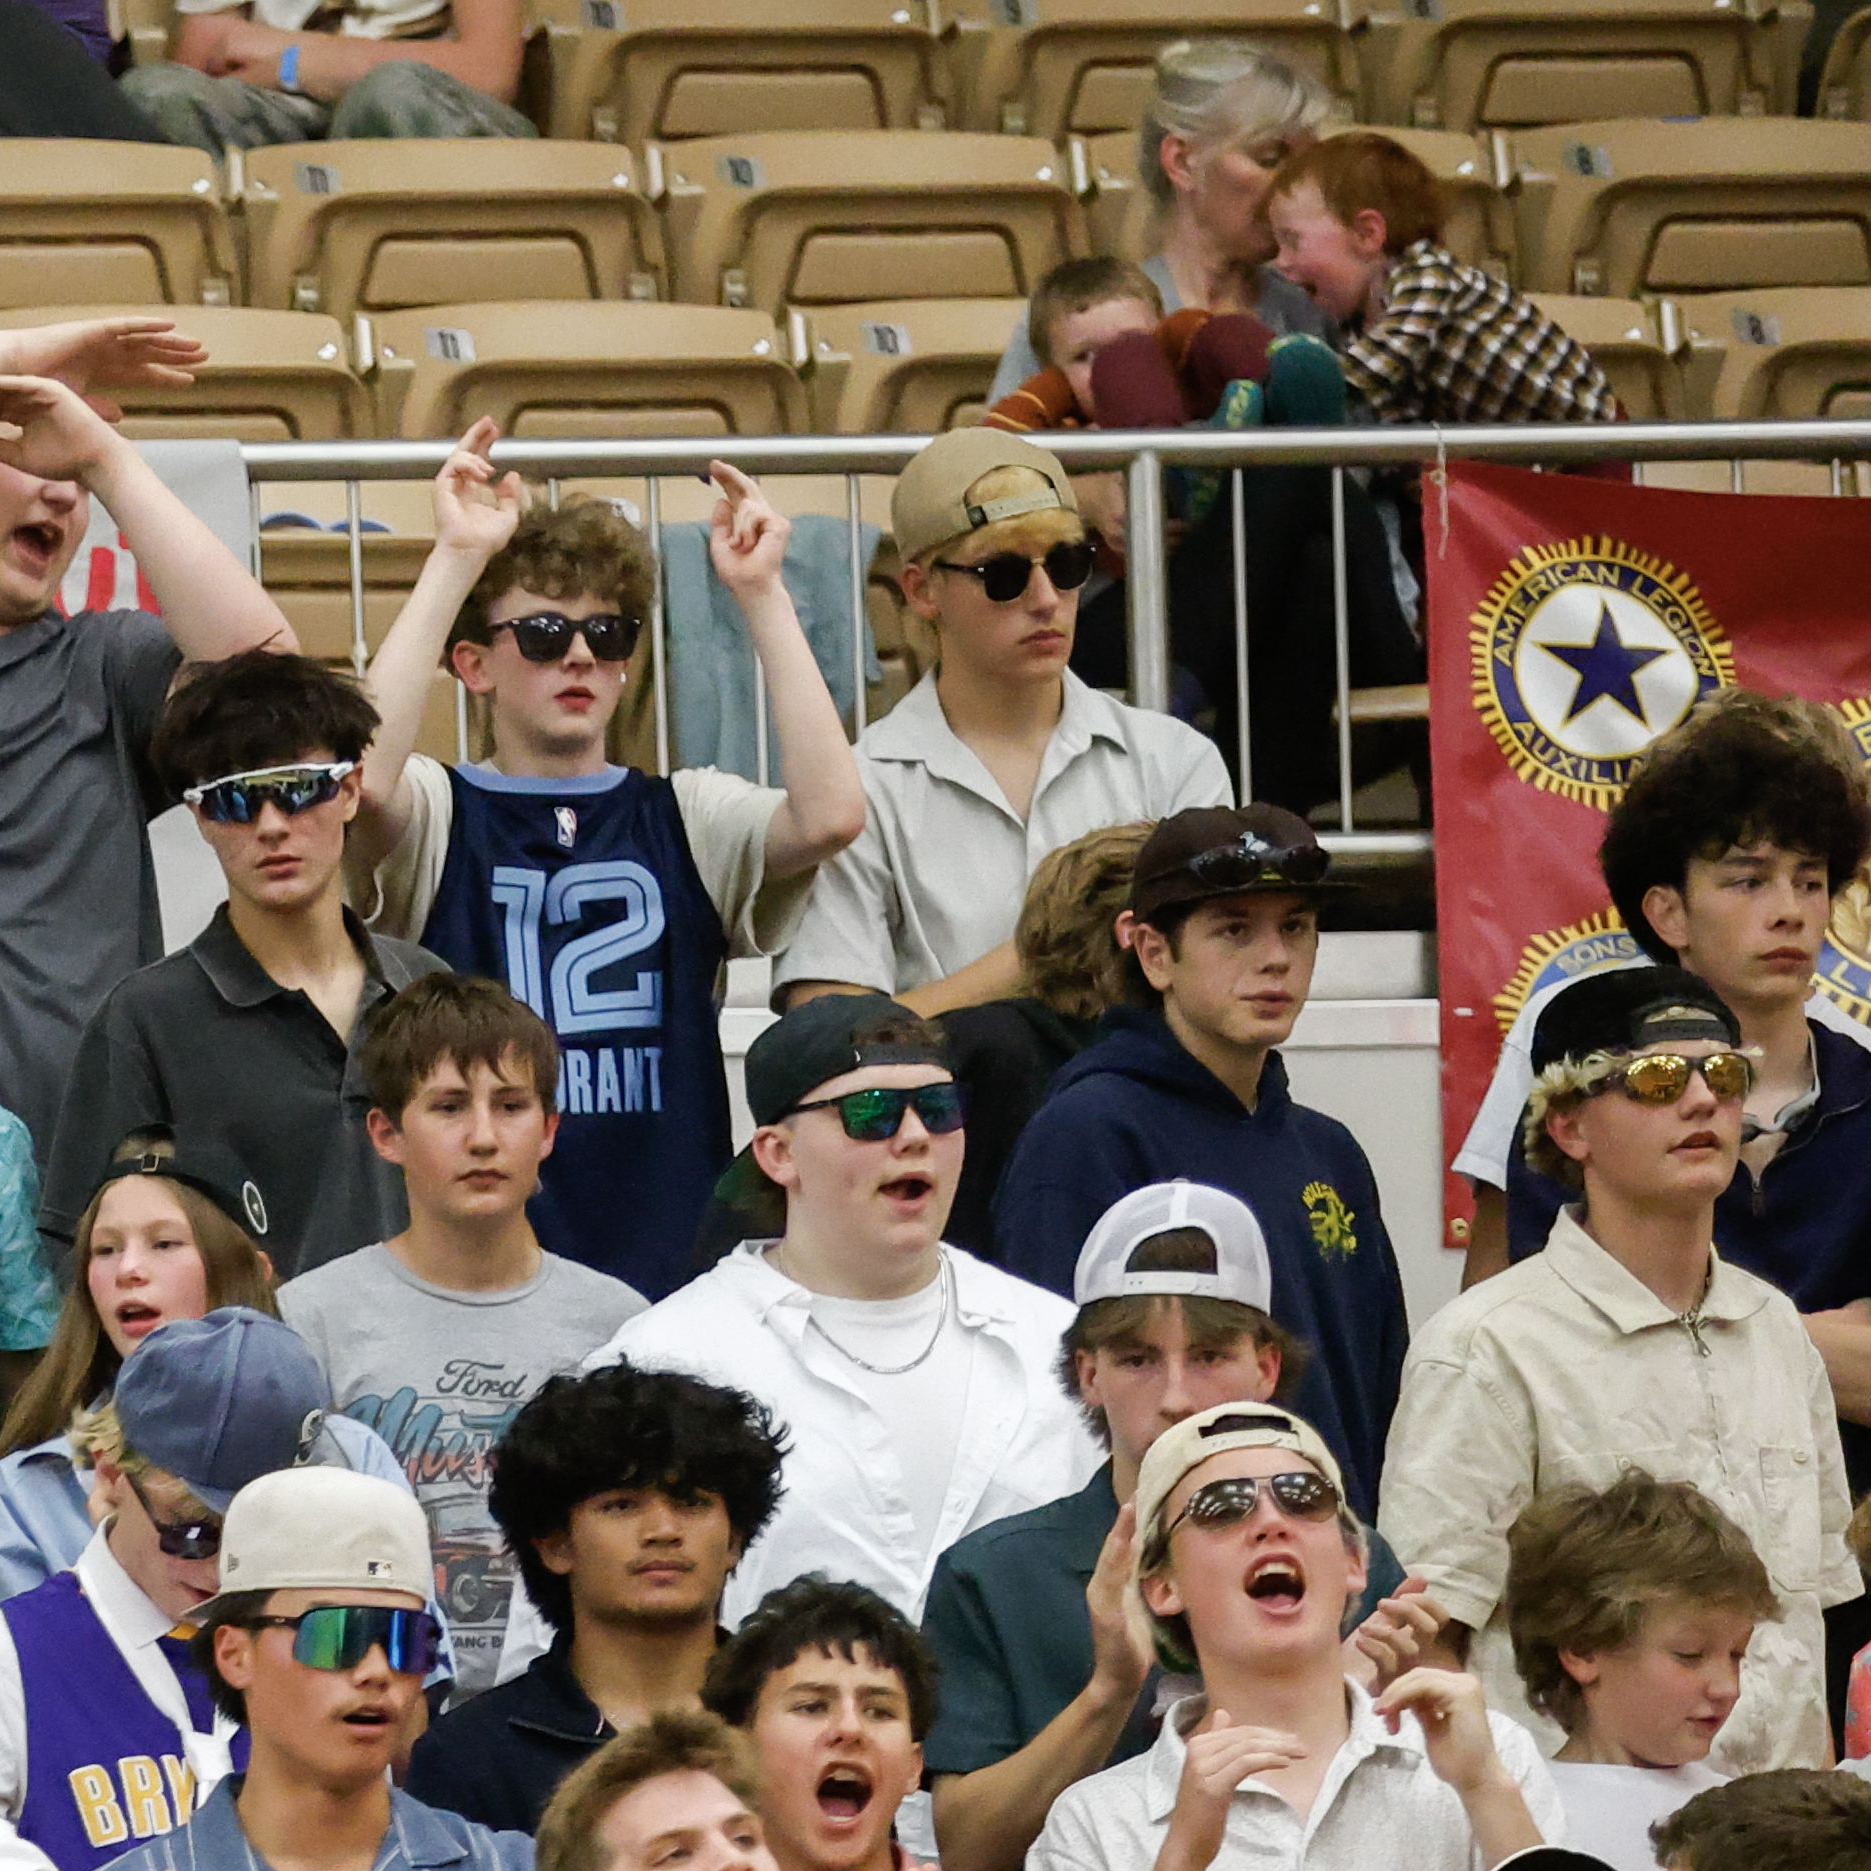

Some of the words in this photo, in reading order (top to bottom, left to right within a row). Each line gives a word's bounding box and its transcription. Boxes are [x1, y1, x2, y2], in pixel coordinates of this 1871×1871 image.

[1492, 563, 1621, 668] AMERICAN
[1631, 575, 1716, 678] LEGION
[1512, 721, 1643, 785] AUXILI
[491, 858, 666, 1036] 12
[1556, 935, 1638, 977] SONS
[554, 1045, 664, 1115] RANT
[436, 1358, 528, 1399] Ford
[67, 1753, 187, 1849] BRY
